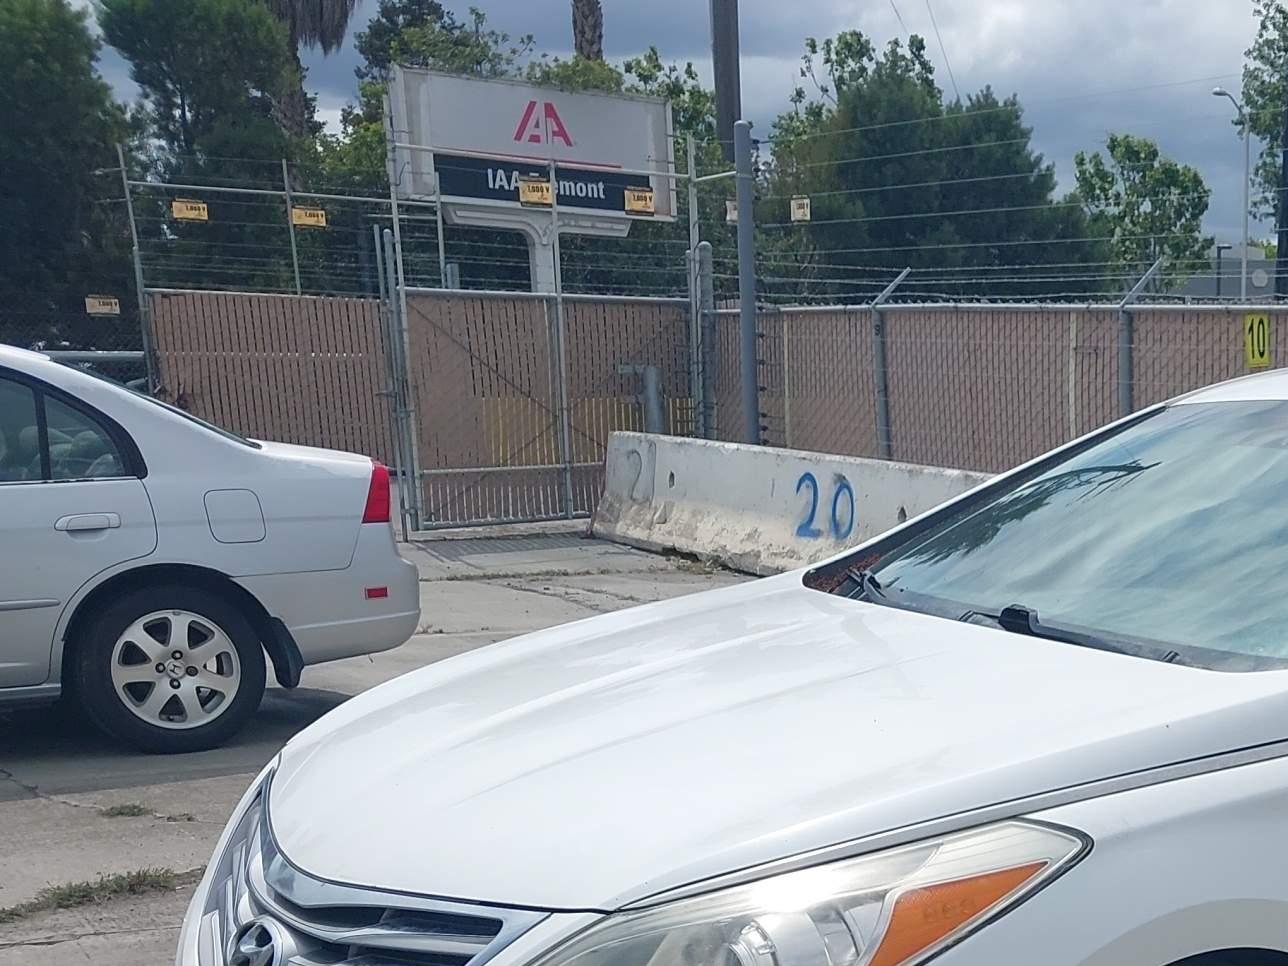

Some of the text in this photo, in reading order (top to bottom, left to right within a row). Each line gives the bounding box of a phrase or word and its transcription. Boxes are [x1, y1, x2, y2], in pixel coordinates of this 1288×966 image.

[487, 168, 520, 191] IAA
[1248, 318, 1266, 359] 10
[795, 471, 855, 540] 20
